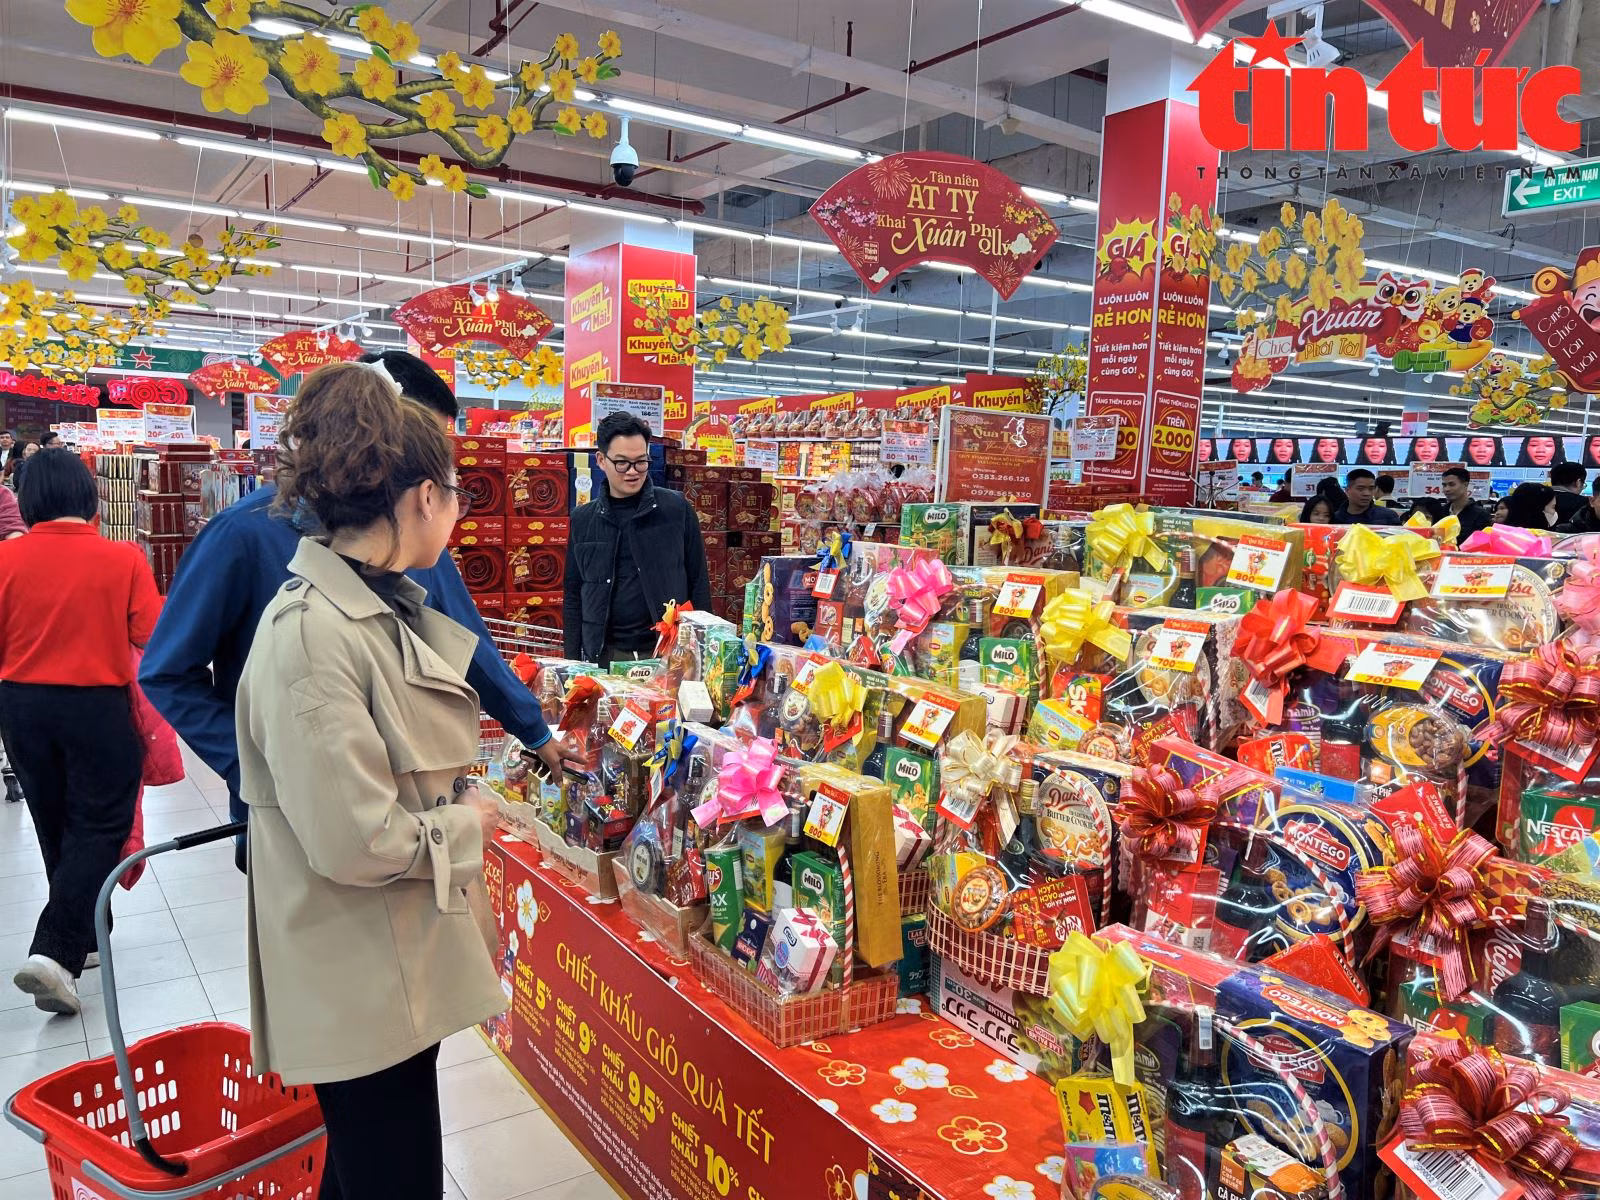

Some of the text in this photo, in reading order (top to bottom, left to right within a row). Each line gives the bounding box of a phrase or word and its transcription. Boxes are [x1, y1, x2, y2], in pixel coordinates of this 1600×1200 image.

[929, 171, 979, 187] Tân niên
[1553, 185, 1586, 202] EXIT
[946, 187, 979, 222] TỴ
[877, 215, 906, 228] Khai
[891, 217, 967, 255] Xuân
[970, 223, 1002, 238] Phú
[1106, 231, 1149, 261] GIÁ
[571, 282, 602, 319] Khuyến
[1099, 291, 1149, 305] LUÔN LUÔN
[1163, 291, 1204, 306] LUÔN LUÔN
[433, 315, 453, 325] Khai
[591, 300, 613, 330] Mãi!
[1093, 307, 1151, 328] RẺ HƠN
[1158, 305, 1206, 329] RẺ HƠN
[1537, 304, 1570, 333] Cung
[442, 317, 493, 338] Xuân
[1298, 303, 1384, 345] Xuân
[629, 337, 673, 354] Khuyến
[1095, 342, 1148, 354] Tiết kiệm hơn
[1159, 341, 1202, 355] Tiết kiệm hơn
[287, 352, 324, 366] Xuân
[1101, 354, 1138, 366] mỗi ngày
[1164, 354, 1195, 367] mỗi ngày
[571, 355, 601, 385] Khuyến
[1100, 365, 1137, 378] cùng GO!
[1163, 367, 1194, 378] cùng GO!
[215, 378, 245, 390] Xuân
[976, 390, 1021, 410] Khuyến
[1166, 415, 1186, 428] TRÊN
[1153, 429, 1193, 448] 2.000
[972, 473, 1031, 483] 0383.266.126
[1424, 486, 1441, 495] 34
[926, 512, 947, 521] MILO
[1235, 572, 1256, 583] 800
[1450, 586, 1478, 594] 700
[1212, 598, 1237, 609] MILO
[993, 650, 1015, 663] MILO
[1158, 658, 1176, 668] 700
[630, 669, 651, 678] MILO
[1363, 675, 1393, 684] 700
[897, 763, 918, 777] MILO
[808, 825, 823, 839] 800
[1287, 826, 1346, 861] MONTEGO
[803, 873, 823, 890] MILO
[516, 958, 535, 983] CHIẾT
[515, 974, 533, 999] KHẤU
[535, 978, 552, 1010] 5%
[556, 997, 577, 1025] CHIẾT
[987, 1003, 1008, 1022] PALMS
[1268, 988, 1345, 1025] MONTEGO
[555, 1014, 576, 1042] KHẤU
[578, 1021, 598, 1055] 9%
[556, 942, 598, 998] CHIẾT
[600, 981, 642, 1043] KHẤU
[646, 1026, 679, 1077] GIỎ
[682, 1061, 727, 1126] QUÀ
[733, 1103, 775, 1165] TẾT
[602, 1043, 626, 1075] CHIẾT
[601, 1061, 624, 1093] KHẤU
[627, 1070, 665, 1124] 9.5%
[671, 1111, 700, 1147] CHIẾT
[671, 1130, 699, 1168] KHẤU
[704, 1143, 740, 1197] 10%
